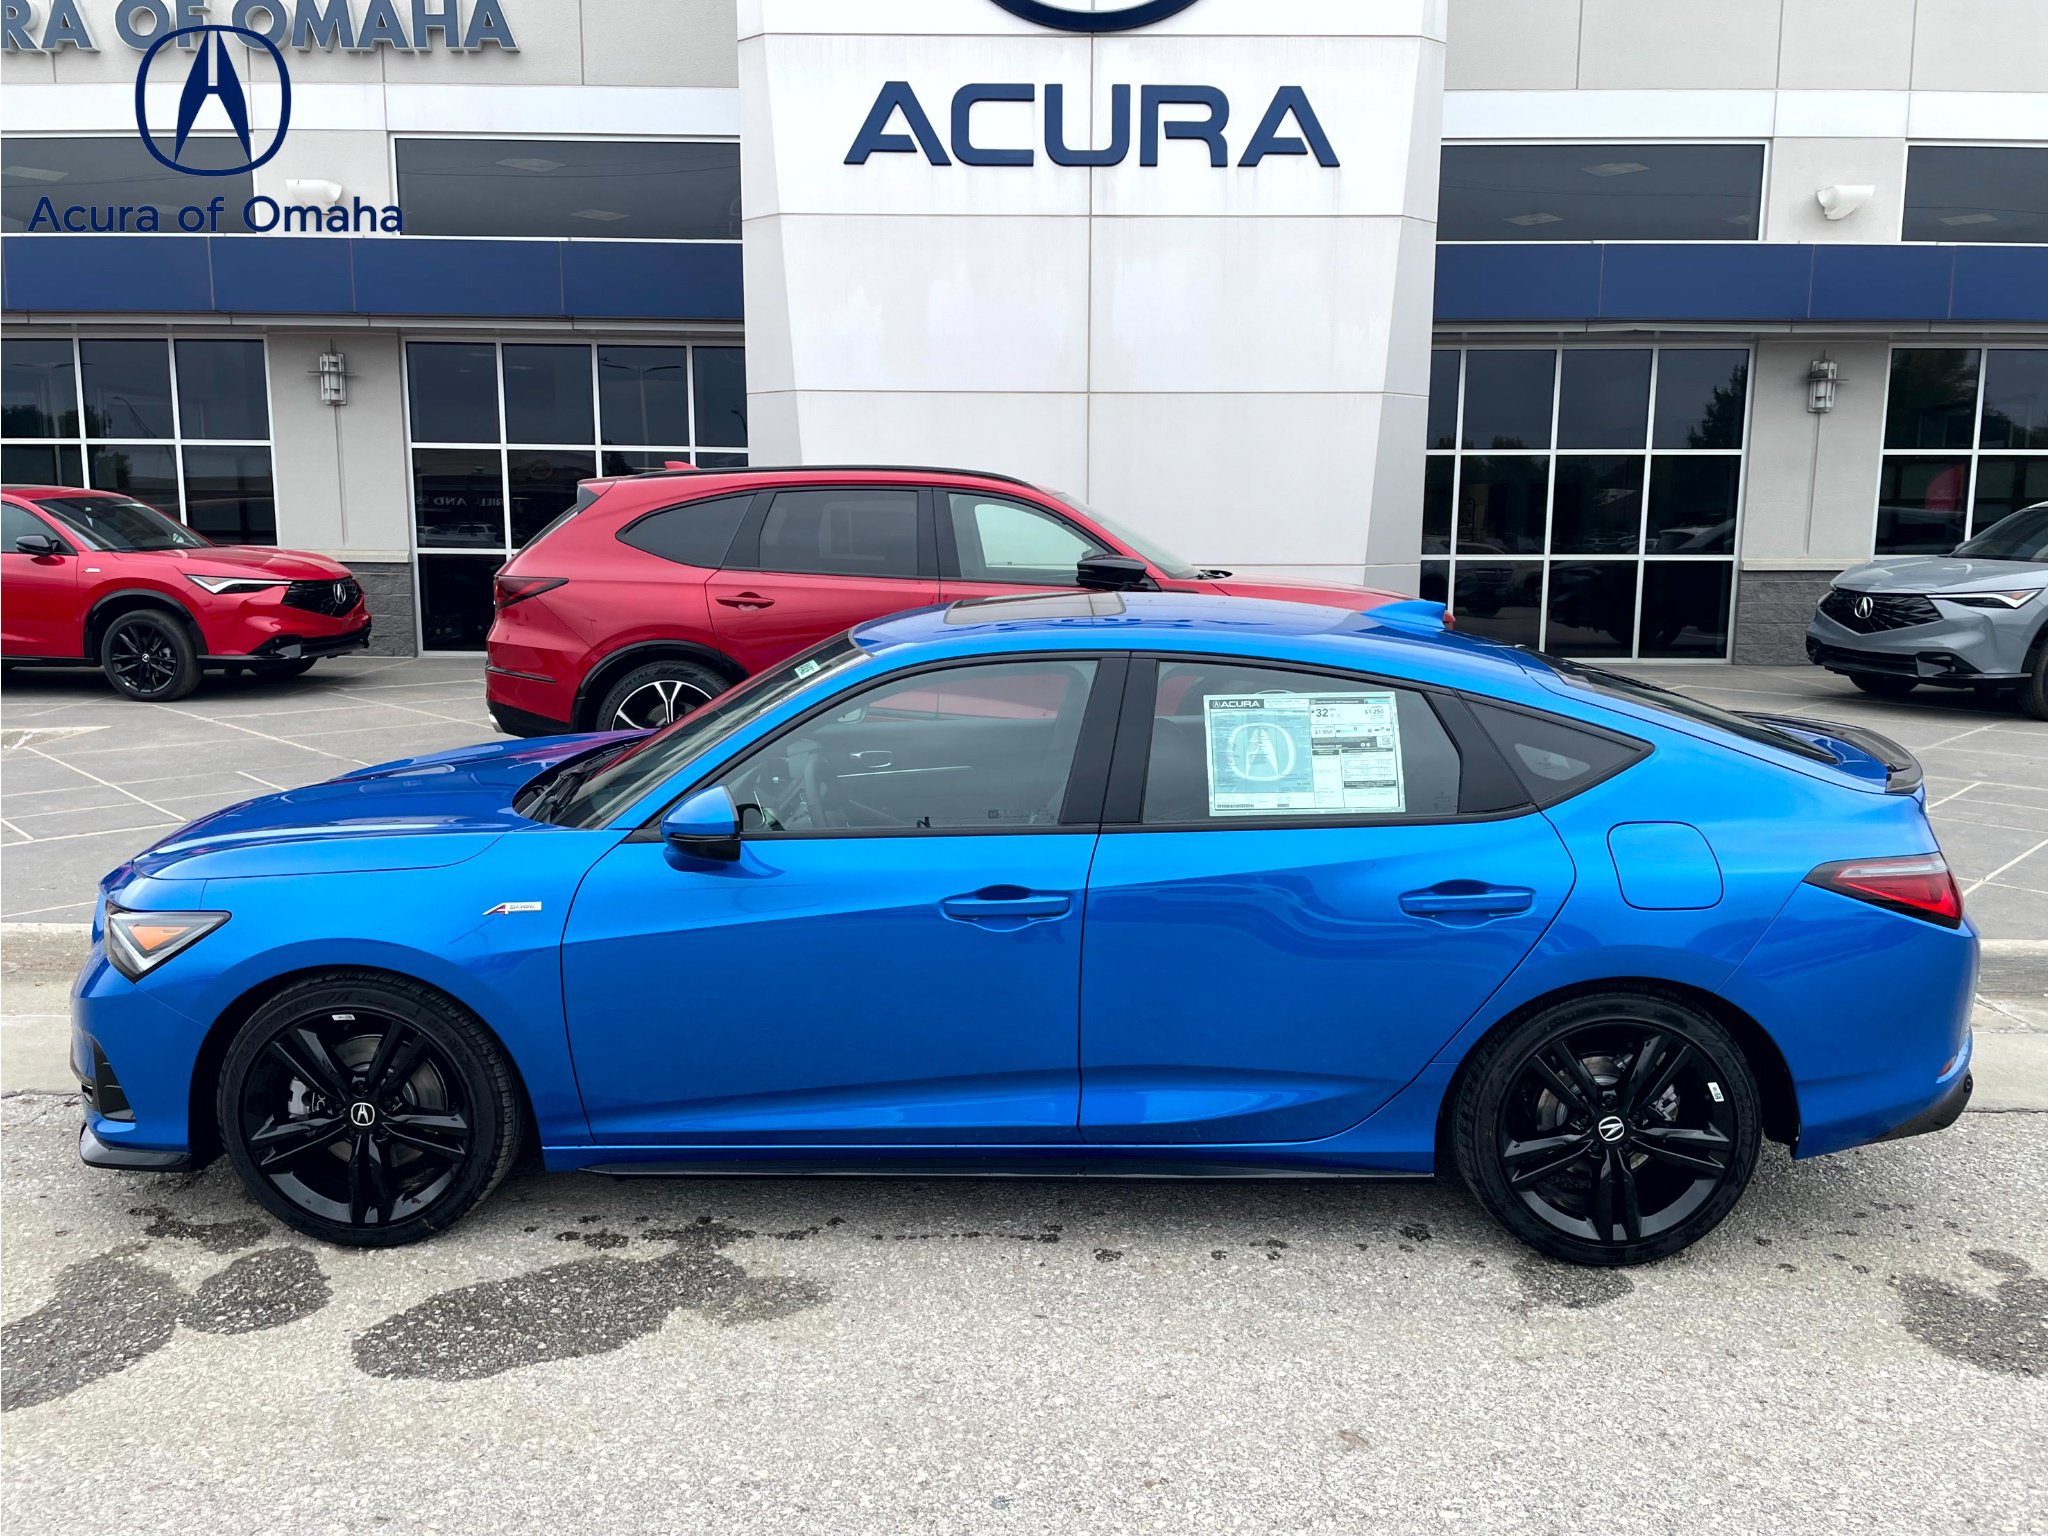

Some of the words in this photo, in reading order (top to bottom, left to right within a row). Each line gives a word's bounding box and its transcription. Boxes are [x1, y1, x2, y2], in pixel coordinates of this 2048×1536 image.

[115, 0, 207, 52] OF
[231, 0, 519, 52] OMAHA
[843, 81, 1341, 168] ACURA
[1220, 700, 1261, 708] ACURA
[1315, 708, 1329, 718] 32
